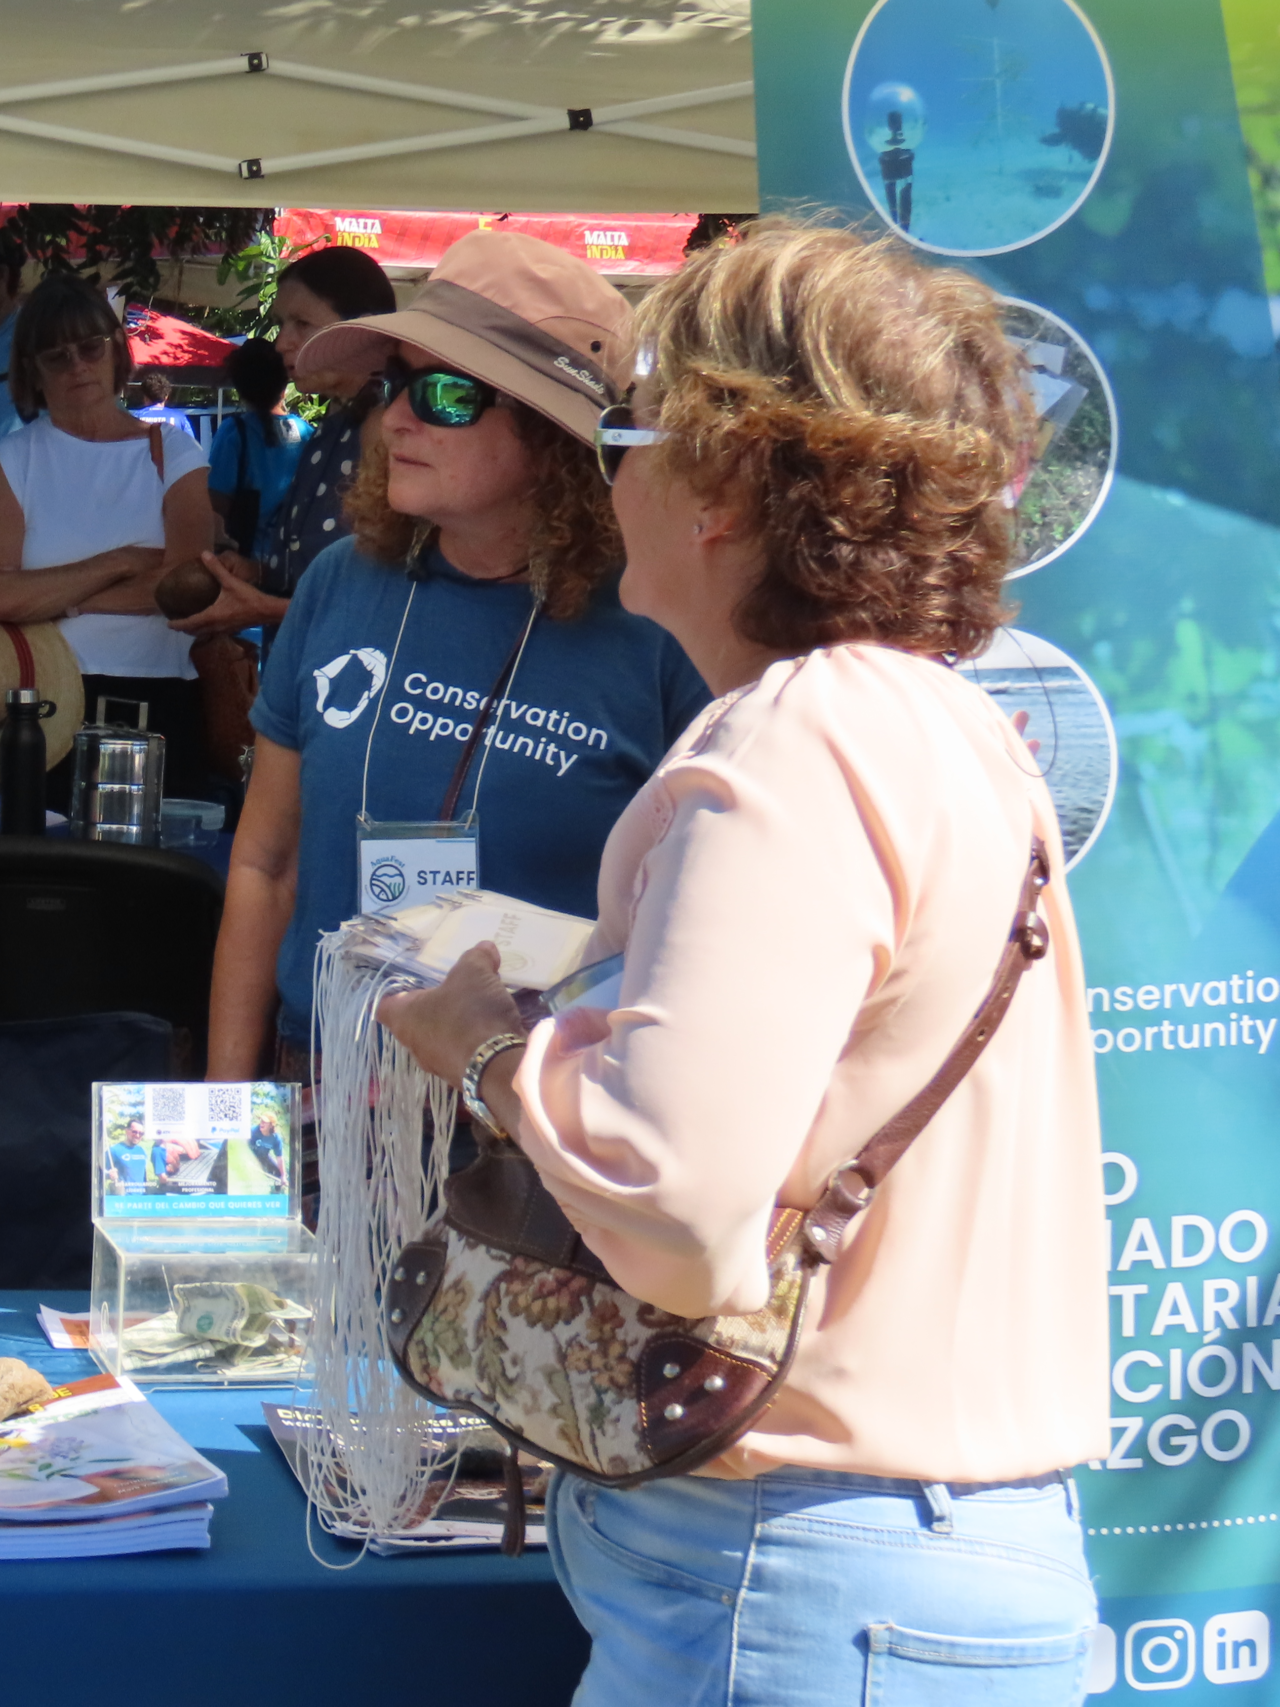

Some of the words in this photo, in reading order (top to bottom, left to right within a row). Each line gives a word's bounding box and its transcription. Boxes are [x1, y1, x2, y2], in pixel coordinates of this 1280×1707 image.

[335, 216, 382, 235] MALTA
[584, 229, 629, 247] MALTA
[403, 671, 609, 751] Conservation
[416, 869, 476, 886] STAFF
[127, 1201, 152, 1209] PARTE
[155, 1201, 169, 1209] DEL
[172, 1201, 206, 1209] CAMBIO
[208, 1201, 226, 1209] QUE
[227, 1200, 263, 1209] QUIERES
[264, 1200, 281, 1209] VER
